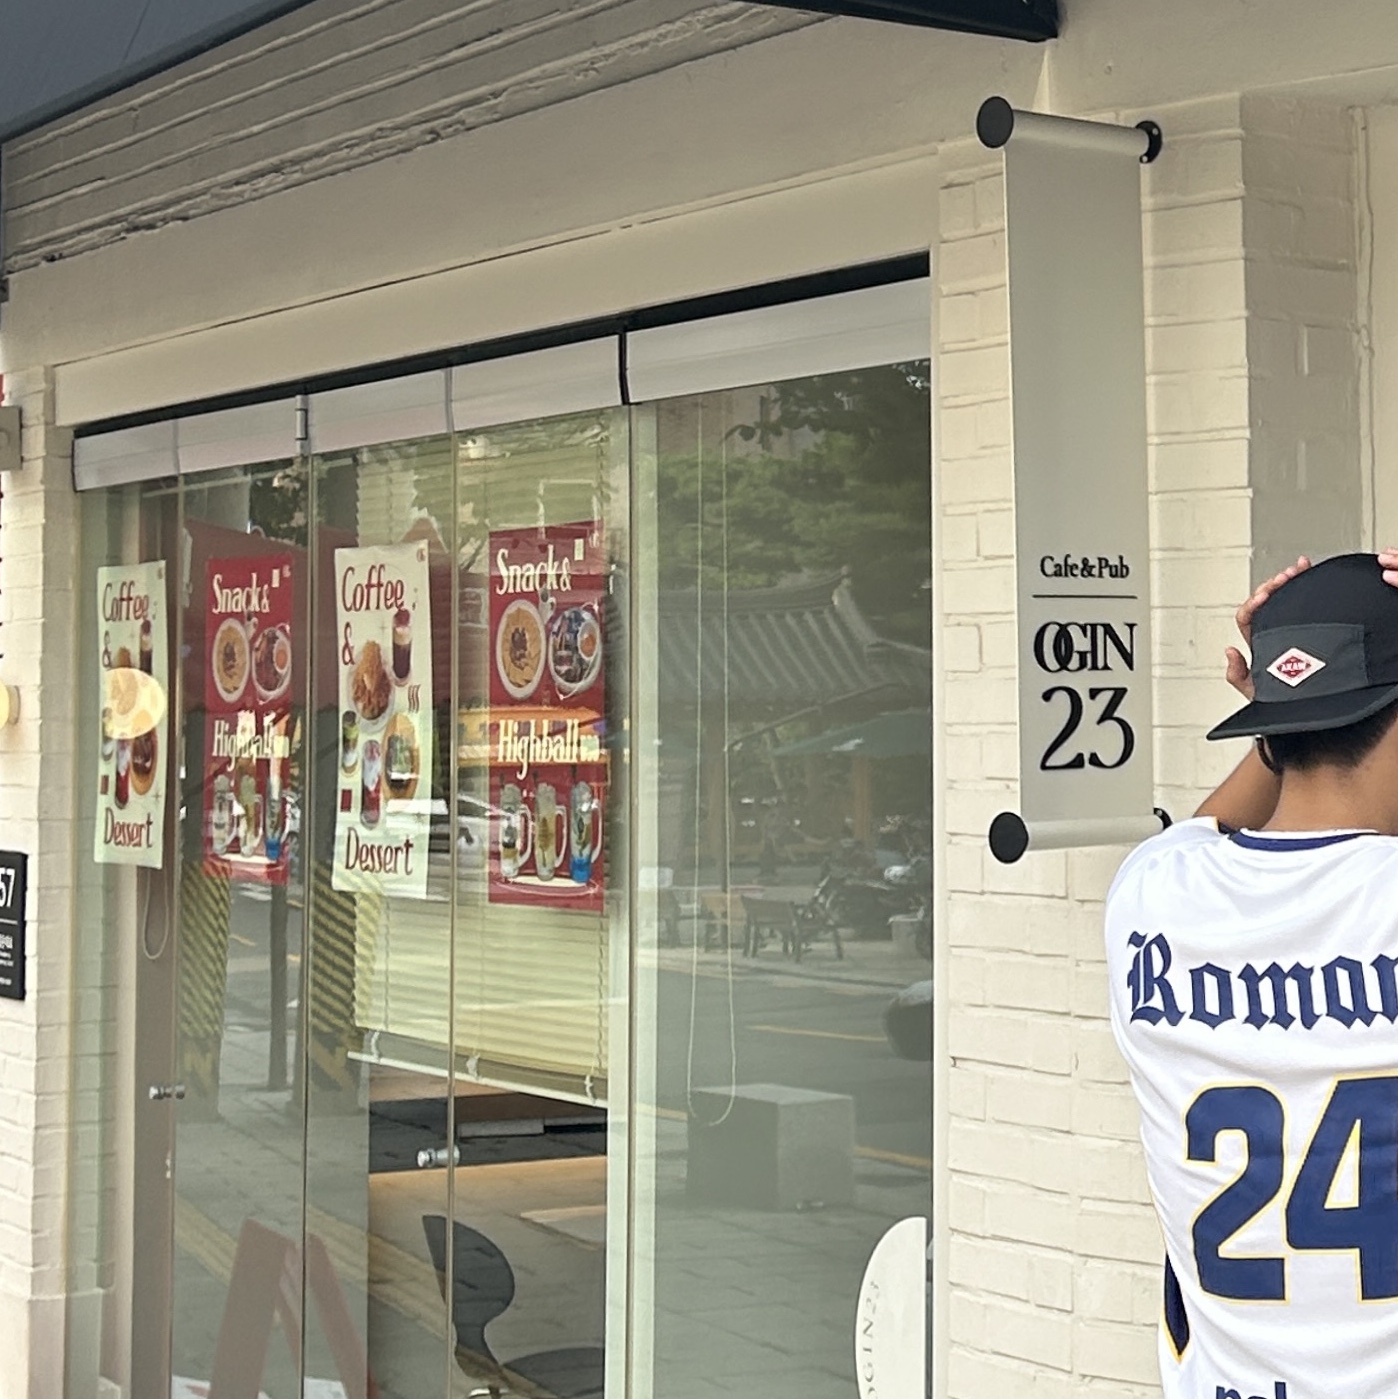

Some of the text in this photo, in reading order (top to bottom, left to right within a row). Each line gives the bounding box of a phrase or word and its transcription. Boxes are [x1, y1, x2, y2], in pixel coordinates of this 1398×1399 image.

[102, 581, 151, 622] Coffee
[342, 563, 405, 613] Coffee
[102, 631, 112, 668] &
[341, 622, 355, 666] &
[1034, 622, 1137, 674] OGIN
[1040, 686, 1135, 771] 23
[104, 807, 153, 850] Dessert
[344, 827, 415, 877] Dessert
